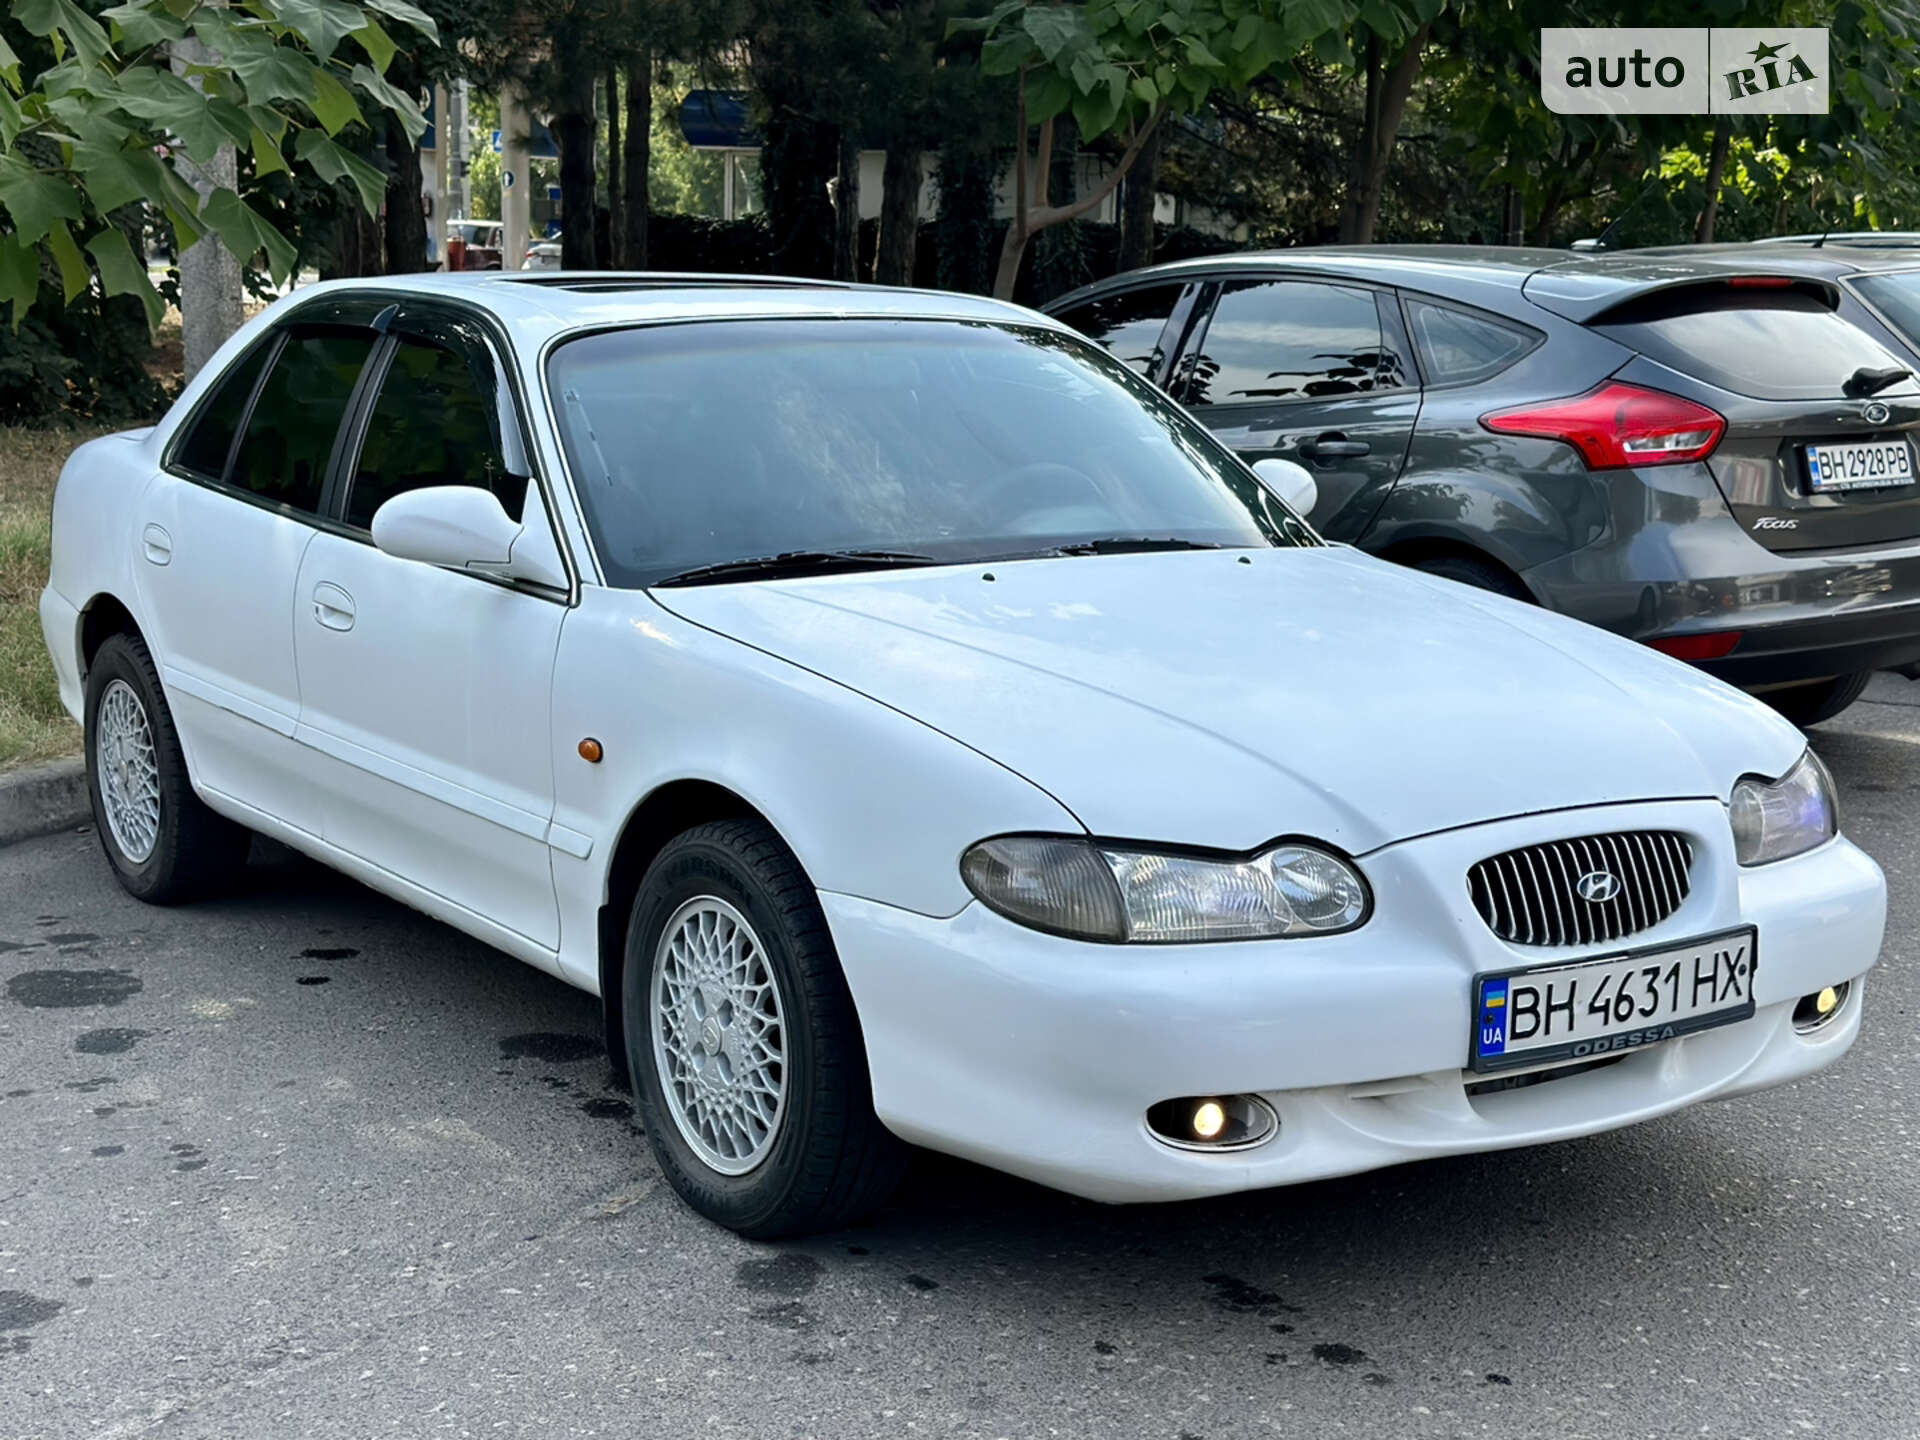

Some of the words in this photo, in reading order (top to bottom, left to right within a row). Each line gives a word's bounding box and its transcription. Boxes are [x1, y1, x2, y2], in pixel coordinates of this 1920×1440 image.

[1752, 516, 1799, 530] Focus
[1510, 979, 1577, 1041] BH
[1588, 961, 1682, 1026] 4631
[1692, 946, 1746, 1007] HX
[1482, 1027, 1503, 1046] UA
[1571, 1024, 1678, 1058] ODESSA
